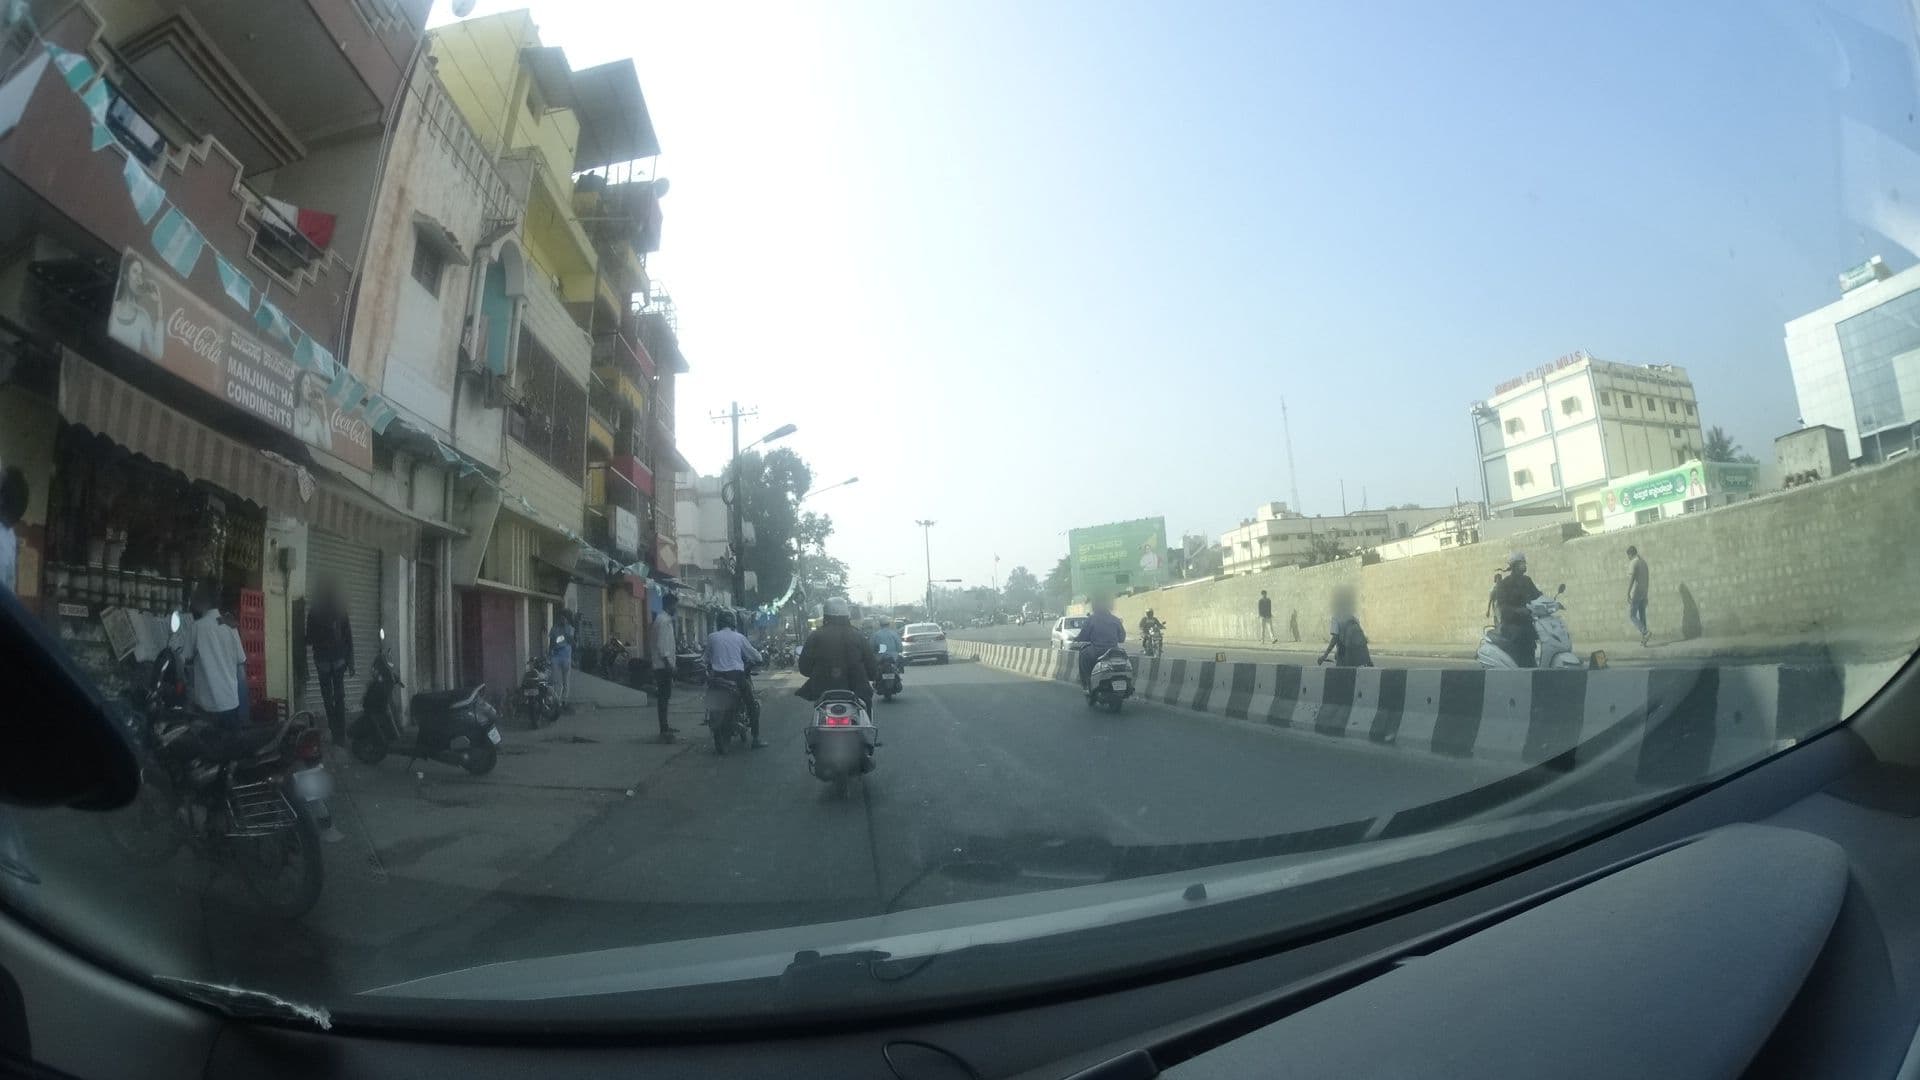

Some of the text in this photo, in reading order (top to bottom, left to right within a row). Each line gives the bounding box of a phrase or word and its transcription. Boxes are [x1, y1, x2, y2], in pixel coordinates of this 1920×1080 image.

[227, 356, 295, 408] MANJUNATHA
[1556, 351, 1582, 370] MILLS
[227, 381, 292, 429] CONDIMENTS
